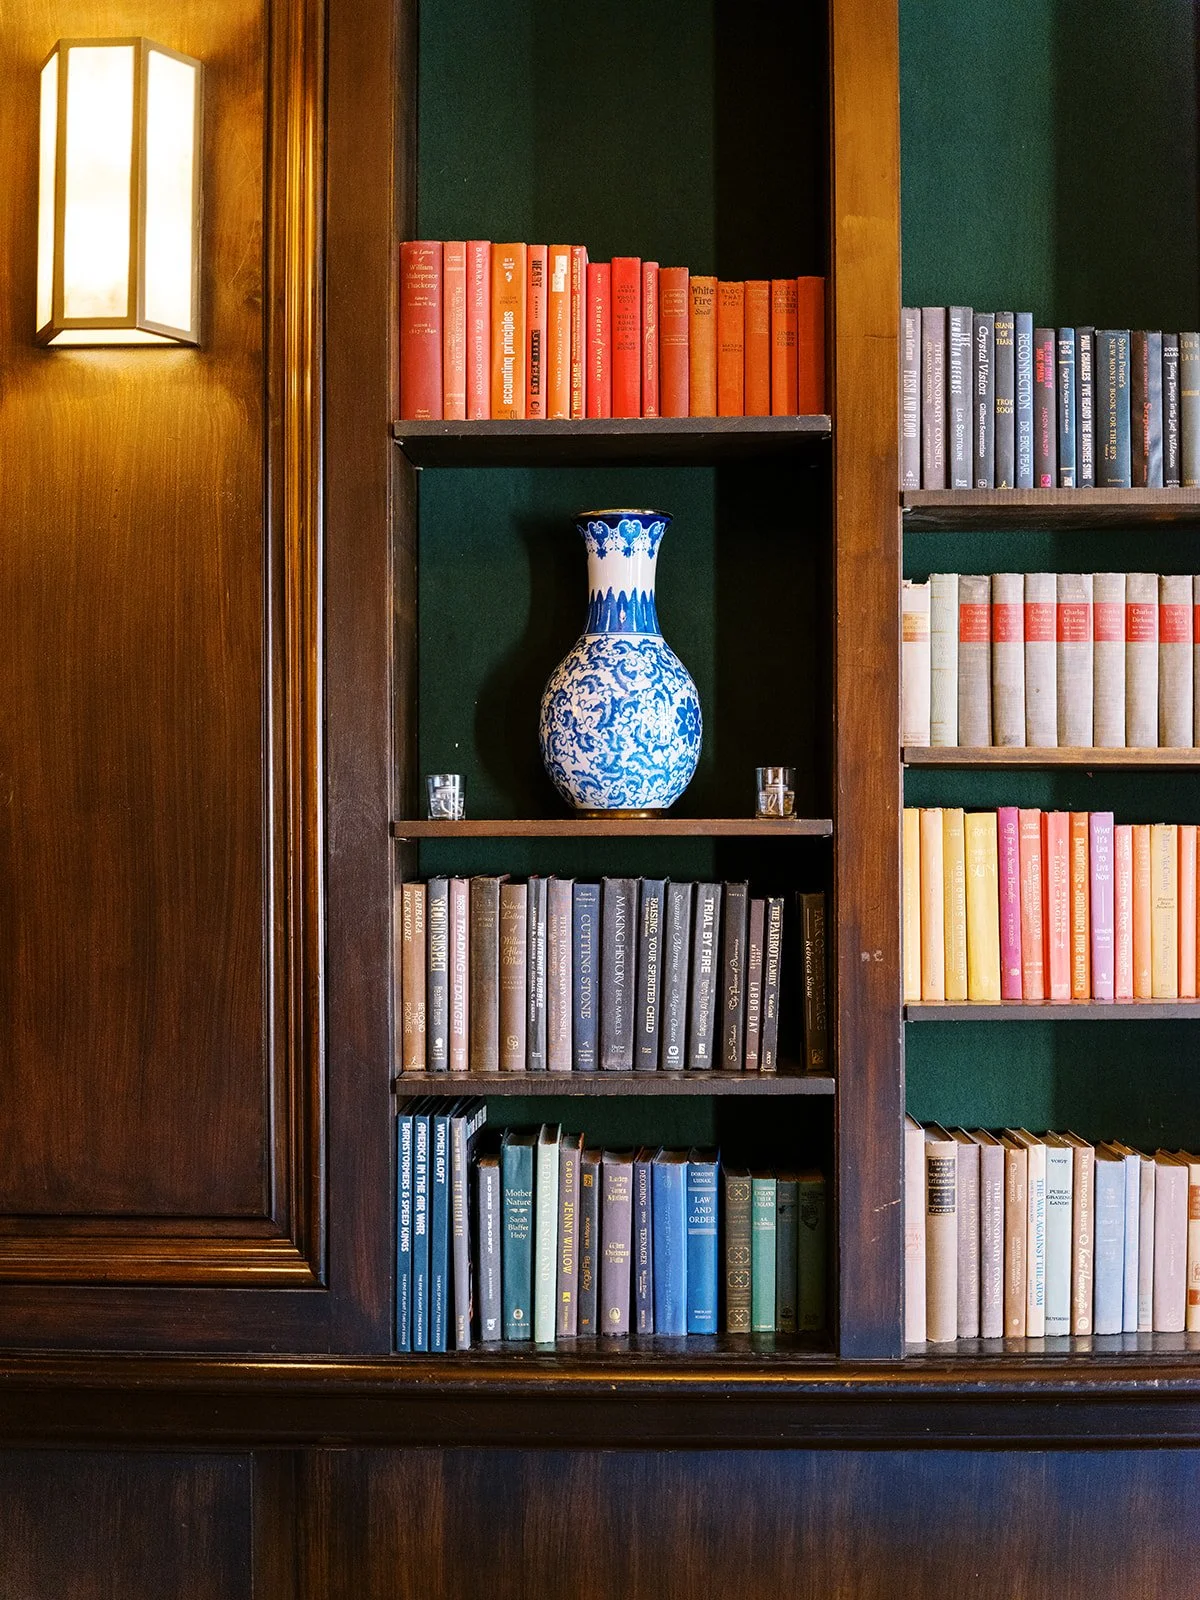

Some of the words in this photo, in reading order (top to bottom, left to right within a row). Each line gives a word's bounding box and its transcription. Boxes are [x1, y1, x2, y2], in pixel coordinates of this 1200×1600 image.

[408, 282, 437, 290] Thackeray
[532, 260, 542, 288] HEART
[692, 286, 714, 295] White
[694, 297, 712, 305] Fire
[503, 311, 514, 354] principles
[592, 338, 606, 346] of
[951, 317, 962, 356] VENDETTA
[960, 333, 970, 347] THE
[977, 326, 989, 363] Crystal
[1081, 335, 1091, 351] PAUL
[934, 342, 942, 364] THE
[1117, 338, 1126, 359] Sylvia
[573, 363, 582, 388] SHARE
[951, 360, 962, 394] DEFENSE
[1018, 333, 1030, 410] RECONNECTION
[1062, 368, 1070, 383] Flight
[1081, 352, 1091, 381] CHARLES
[1118, 361, 1126, 388] Porter's
[503, 357, 514, 405] accounting
[904, 370, 917, 395] FLESH
[978, 365, 989, 395] Vision
[573, 390, 582, 410] YOUR
[904, 396, 917, 412] AND
[934, 367, 942, 424] HONORARY
[1082, 397, 1092, 419] HEARD
[904, 414, 916, 438] BLOOD
[1019, 421, 1029, 434] DR.
[1082, 420, 1092, 433] THE
[1143, 401, 1152, 457] Serpentine
[934, 427, 942, 468] CONSUL
[1019, 435, 1029, 452] ERIC
[1082, 433, 1092, 463] BANSHEE
[1019, 453, 1029, 477] PEARL
[1082, 464, 1092, 480] SING
[1132, 608, 1153, 616] Charles
[1094, 826, 1111, 834] What
[1097, 835, 1107, 844] It's
[1161, 833, 1171, 852] Mary
[1073, 837, 1085, 882] Sheppard
[1096, 845, 1109, 854] Like
[1096, 864, 1109, 872] Live
[1096, 873, 1111, 881] Now
[1161, 854, 1172, 892] McCarthy
[1119, 870, 1129, 893] Help
[414, 890, 423, 934] BARBARA
[703, 898, 714, 929] TRIAL
[771, 905, 780, 921] THE
[1073, 890, 1086, 932] Conquer
[1120, 896, 1129, 909] the
[403, 890, 412, 942] BICKMORE
[615, 896, 625, 942] MAKING
[649, 897, 659, 934] RAISING
[456, 918, 465, 972] TRADING
[580, 914, 591, 974] CUTTING
[648, 936, 657, 962] YOUR
[702, 932, 713, 947] BY
[768, 921, 780, 960] PARROT
[1074, 935, 1086, 953] and
[613, 945, 625, 987] HISTORY
[701, 949, 712, 973] FIRE
[805, 940, 813, 974] Rebecca
[456, 974, 463, 984] IN
[647, 964, 656, 1003] SPIRITED
[768, 959, 777, 987] FAMILY
[1074, 955, 1086, 991] Endure
[433, 985, 443, 1007] Heather
[536, 977, 544, 1008] BUBBLE
[580, 976, 591, 1019] STONE
[749, 982, 759, 1011] LABOR
[806, 976, 814, 998] Shaw
[434, 1008, 443, 1026] Lewis
[453, 985, 463, 1035] DANGER
[646, 1005, 655, 1033] CHILD
[749, 1016, 758, 1033] DAY
[416, 1122, 426, 1162] AMERICA
[436, 1123, 446, 1156] WOMEN
[401, 1122, 411, 1189] BARNSTORMERS
[1081, 1154, 1089, 1169] THE
[416, 1164, 426, 1174] IN
[436, 1157, 446, 1183] ALOFT
[565, 1160, 573, 1193] GADDIS
[416, 1175, 426, 1193] THE
[505, 1188, 532, 1197] Mother
[542, 1152, 551, 1214] MEDIEVAL
[993, 1180, 1001, 1201] THE
[1009, 1162, 1018, 1202] Chiropractic
[1036, 1178, 1045, 1199] THE
[1080, 1171, 1089, 1208] TATTOOED
[416, 1195, 426, 1211] AIR
[505, 1198, 532, 1206] Nature
[694, 1196, 711, 1204] LAW
[1036, 1200, 1045, 1219] WAR
[401, 1200, 410, 1226] SPEED
[415, 1213, 426, 1235] WAR
[563, 1201, 573, 1234] JENNY
[689, 1216, 716, 1224] ORDER
[1080, 1210, 1088, 1232] MUSE
[400, 1227, 410, 1252] KINGS
[993, 1206, 1001, 1262] HONORARY
[1036, 1220, 1045, 1260] AGAINST
[542, 1220, 551, 1281] ENGLAND
[563, 1236, 572, 1275] WILLOW
[1078, 1247, 1091, 1268] Kent
[1036, 1261, 1044, 1279] THE
[992, 1267, 1001, 1308] CONSUL
[1036, 1279, 1044, 1306] ATOM
[1075, 1269, 1090, 1315] Harrington
